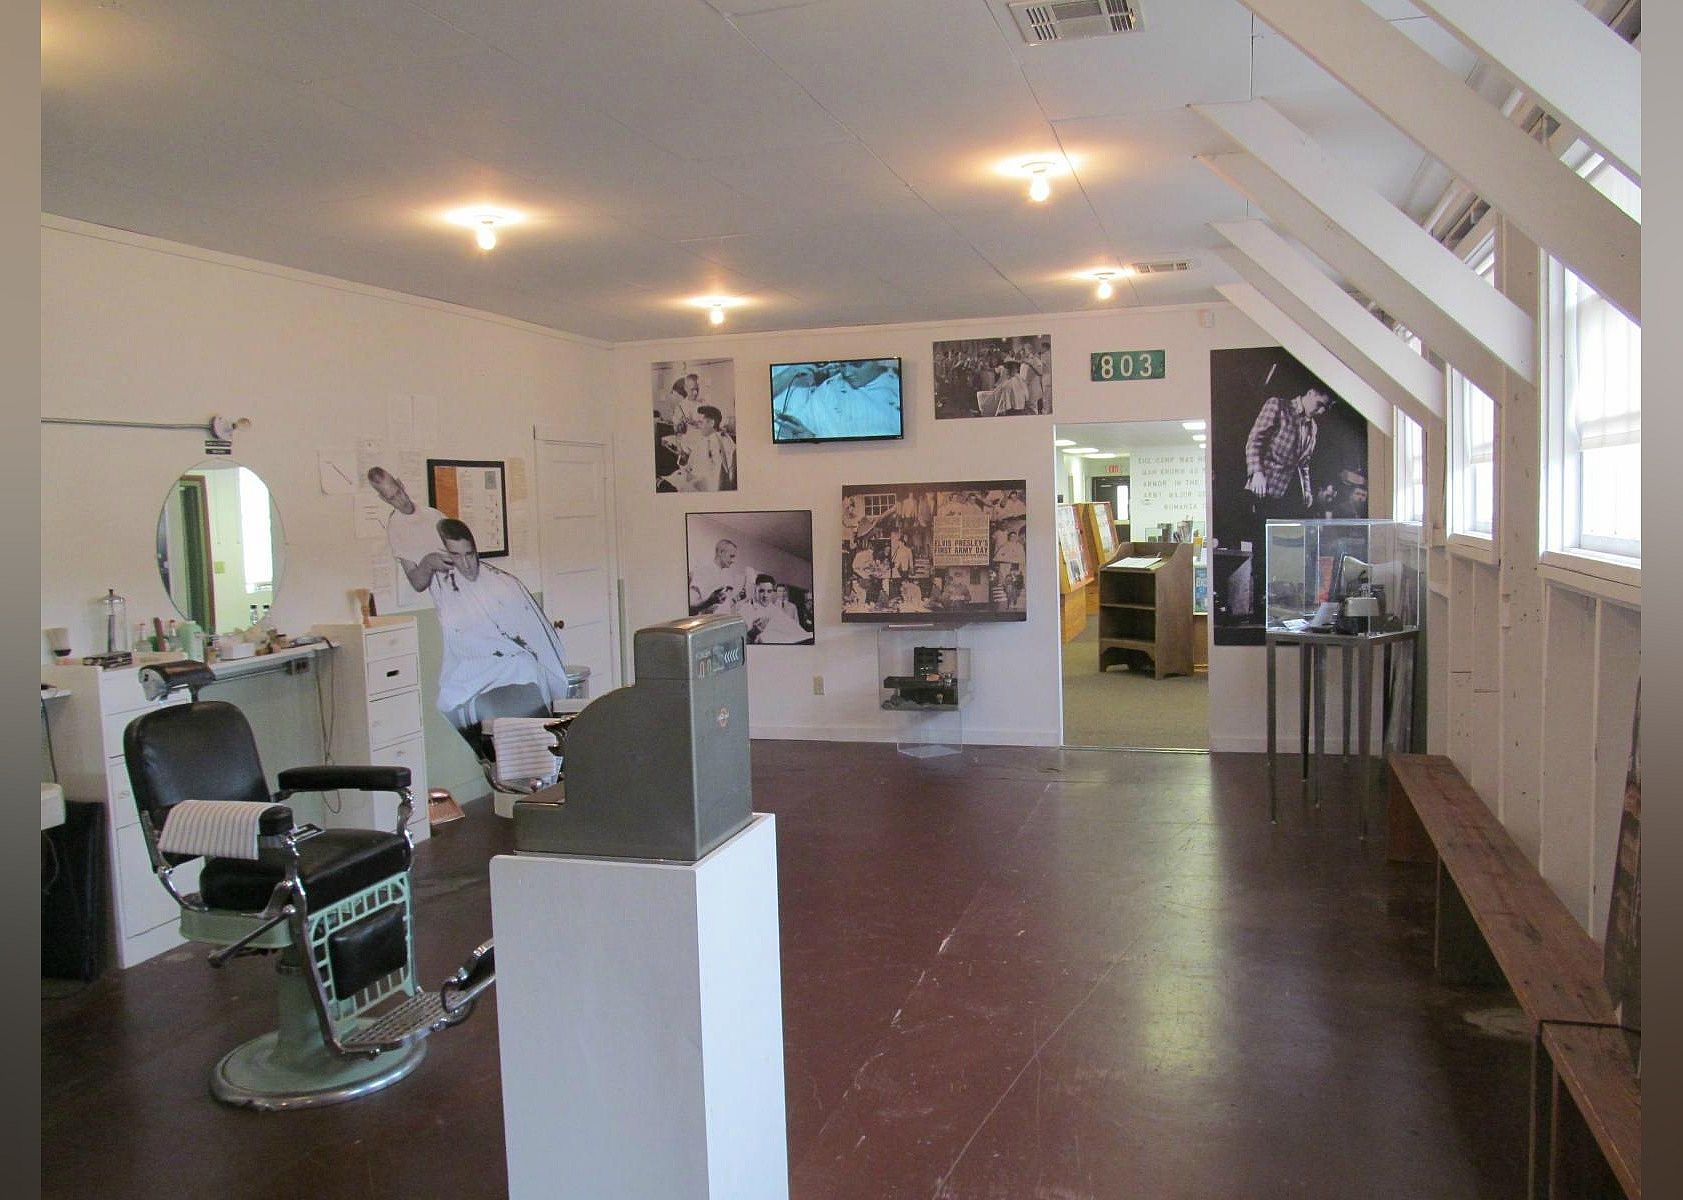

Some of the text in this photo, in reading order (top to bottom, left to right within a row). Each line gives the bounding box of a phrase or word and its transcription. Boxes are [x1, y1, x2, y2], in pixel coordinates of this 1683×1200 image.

[1101, 353, 1152, 379] 803
[934, 539, 988, 547] ELVIS PRESLEY'S
